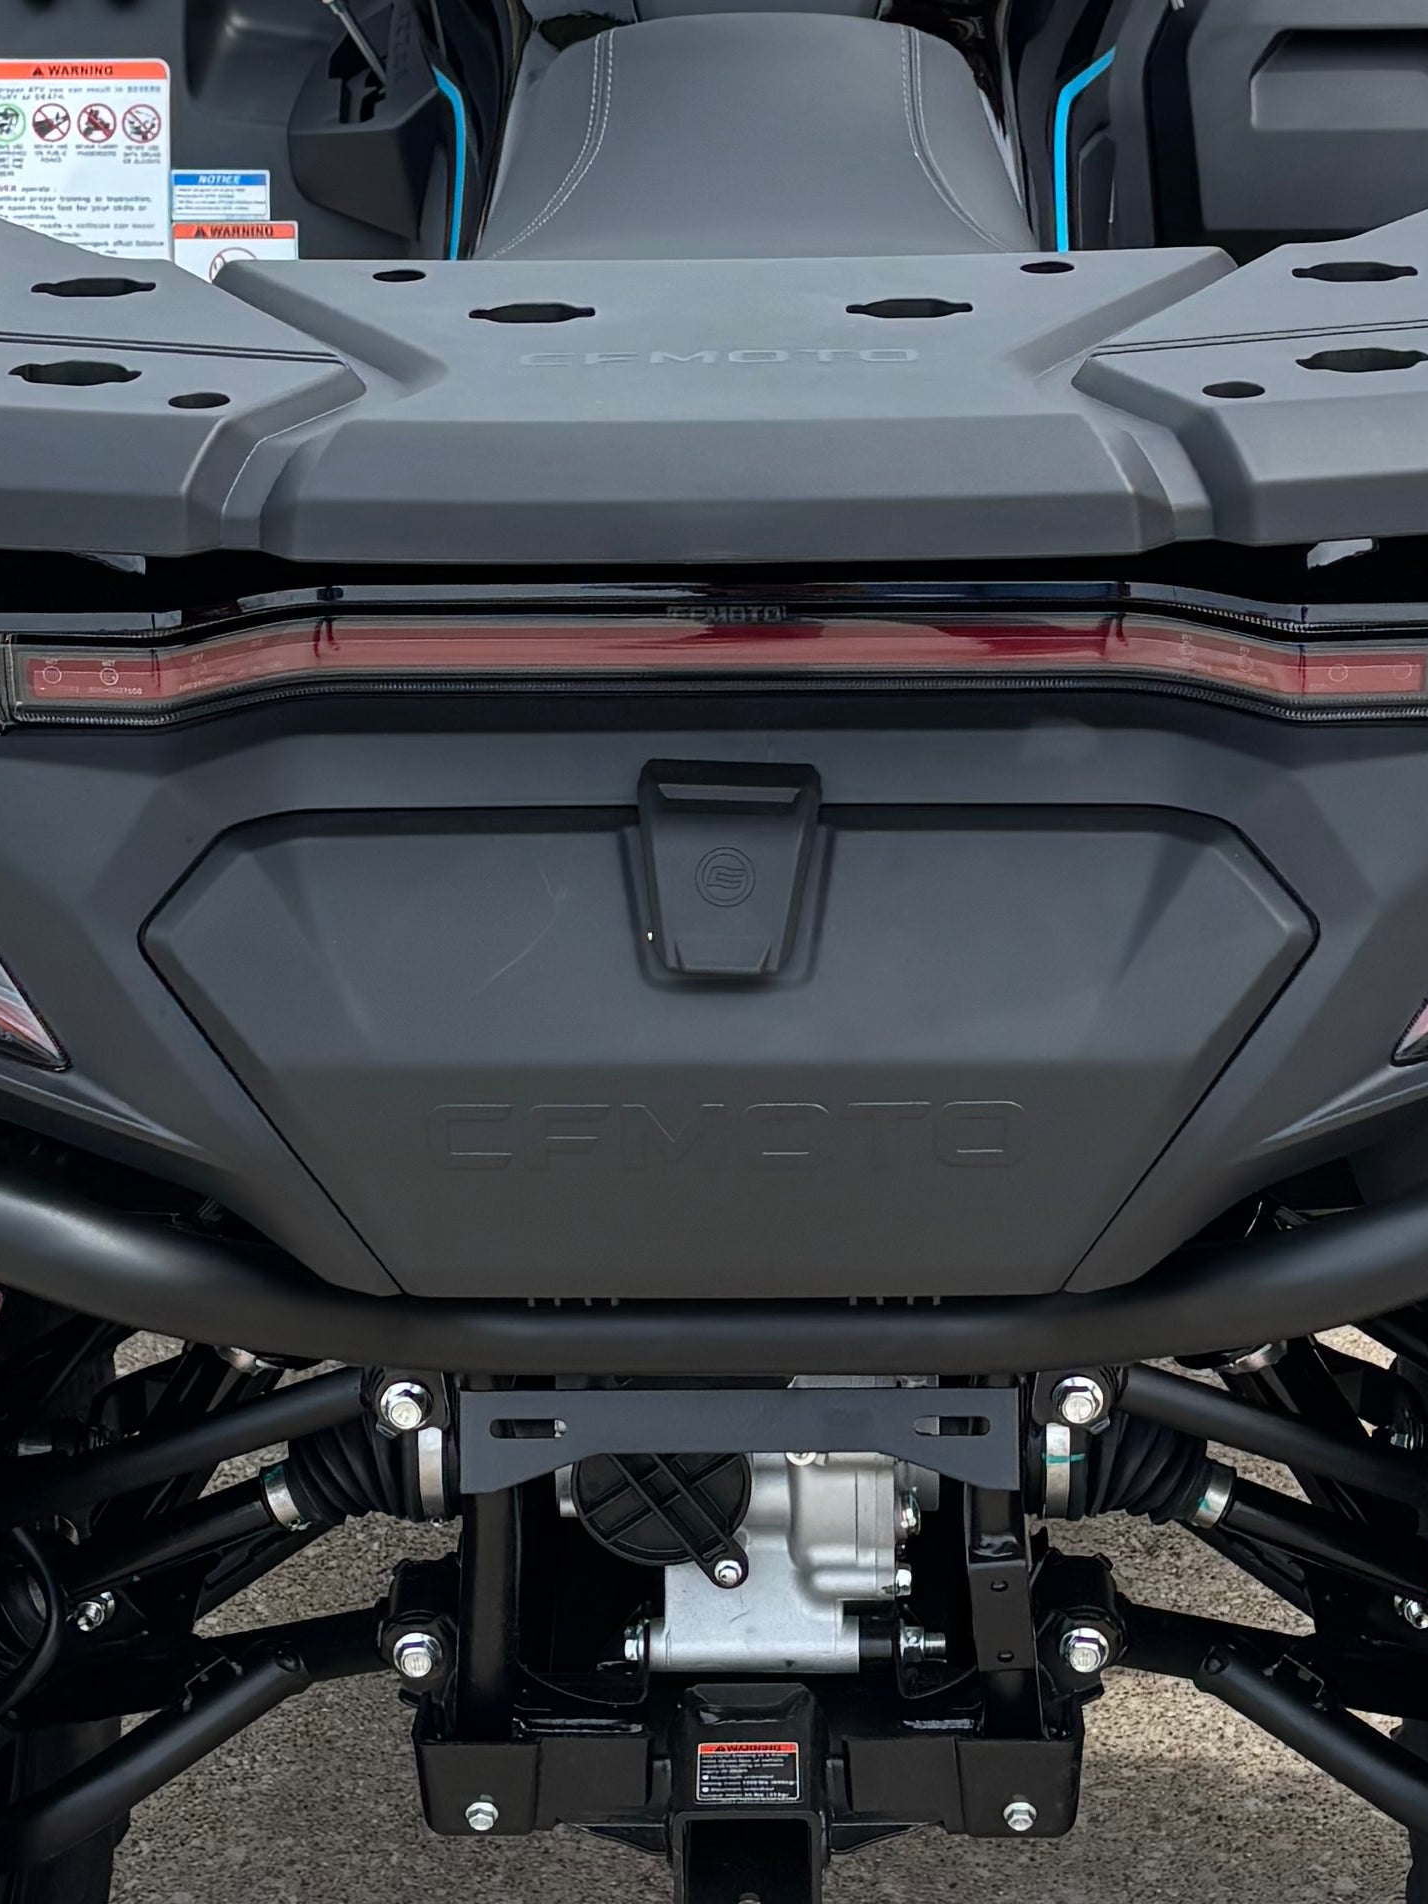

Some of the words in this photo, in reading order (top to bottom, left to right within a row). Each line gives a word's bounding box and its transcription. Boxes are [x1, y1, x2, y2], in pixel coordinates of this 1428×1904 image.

[48, 65, 114, 76] WARNING
[197, 175, 242, 184] NOTICE
[210, 224, 274, 236] WARNING
[519, 348, 920, 366] CFMOTO
[426, 1100, 1028, 1169] CFMOTO
